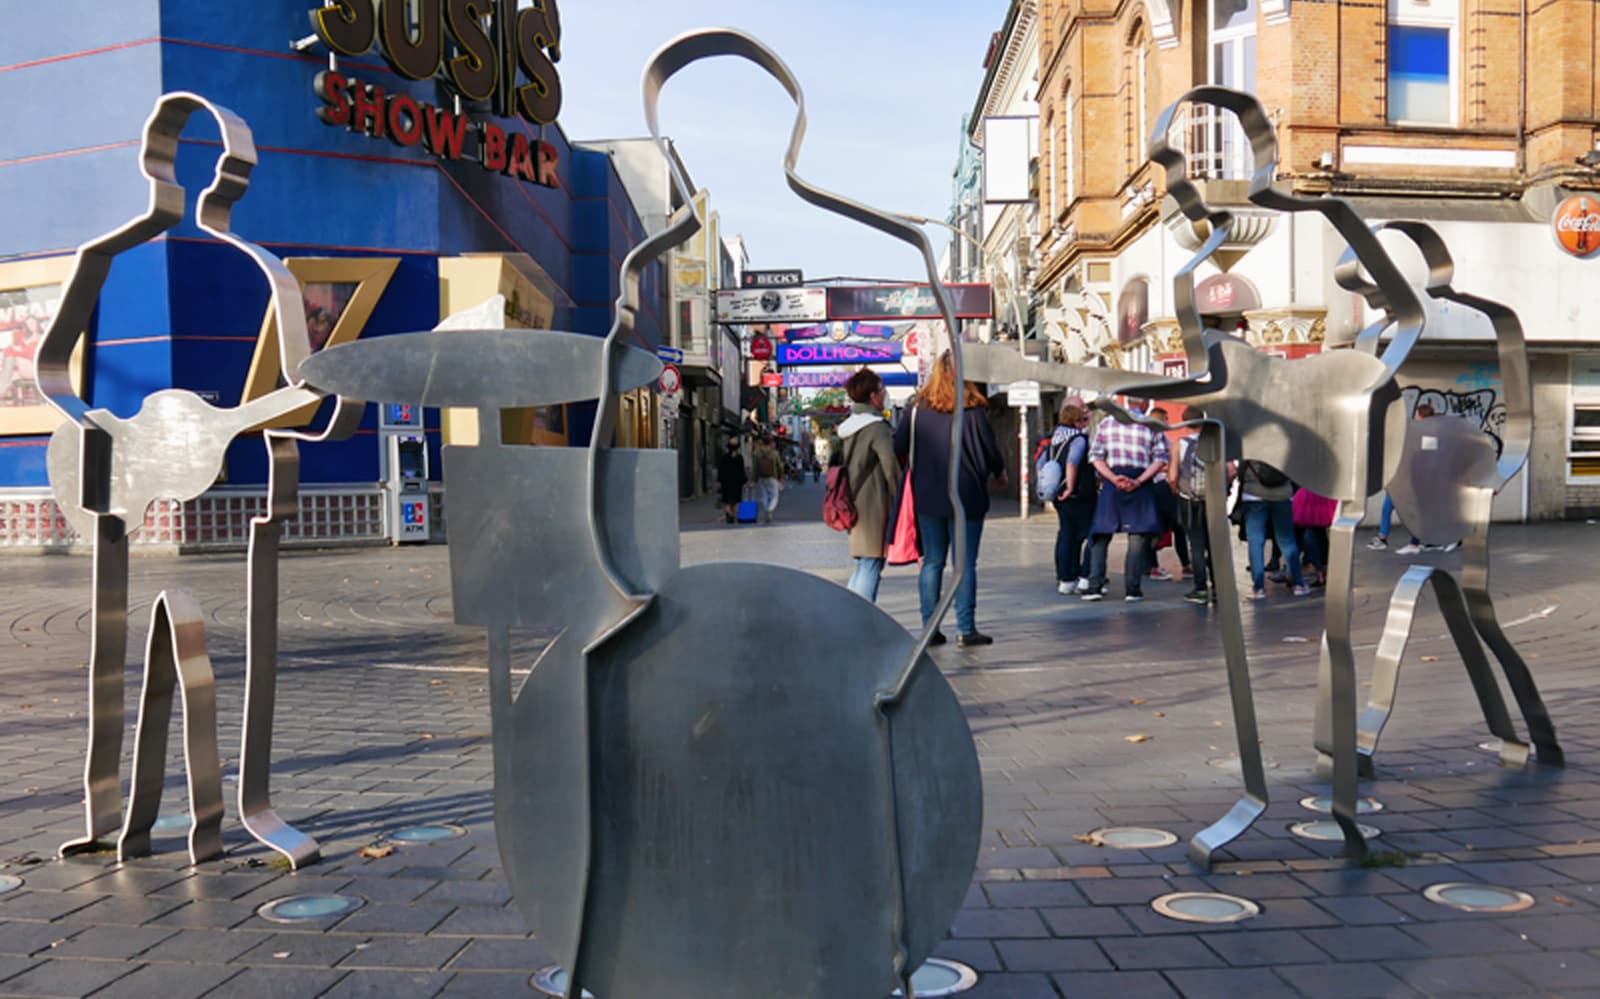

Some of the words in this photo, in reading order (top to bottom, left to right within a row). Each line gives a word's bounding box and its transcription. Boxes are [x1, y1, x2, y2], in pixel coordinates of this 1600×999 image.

[314, 69, 467, 160] SHOW
[480, 122, 560, 189] BAR
[786, 344, 893, 361] DOLLHOUSE
[405, 525, 424, 534] ATM
